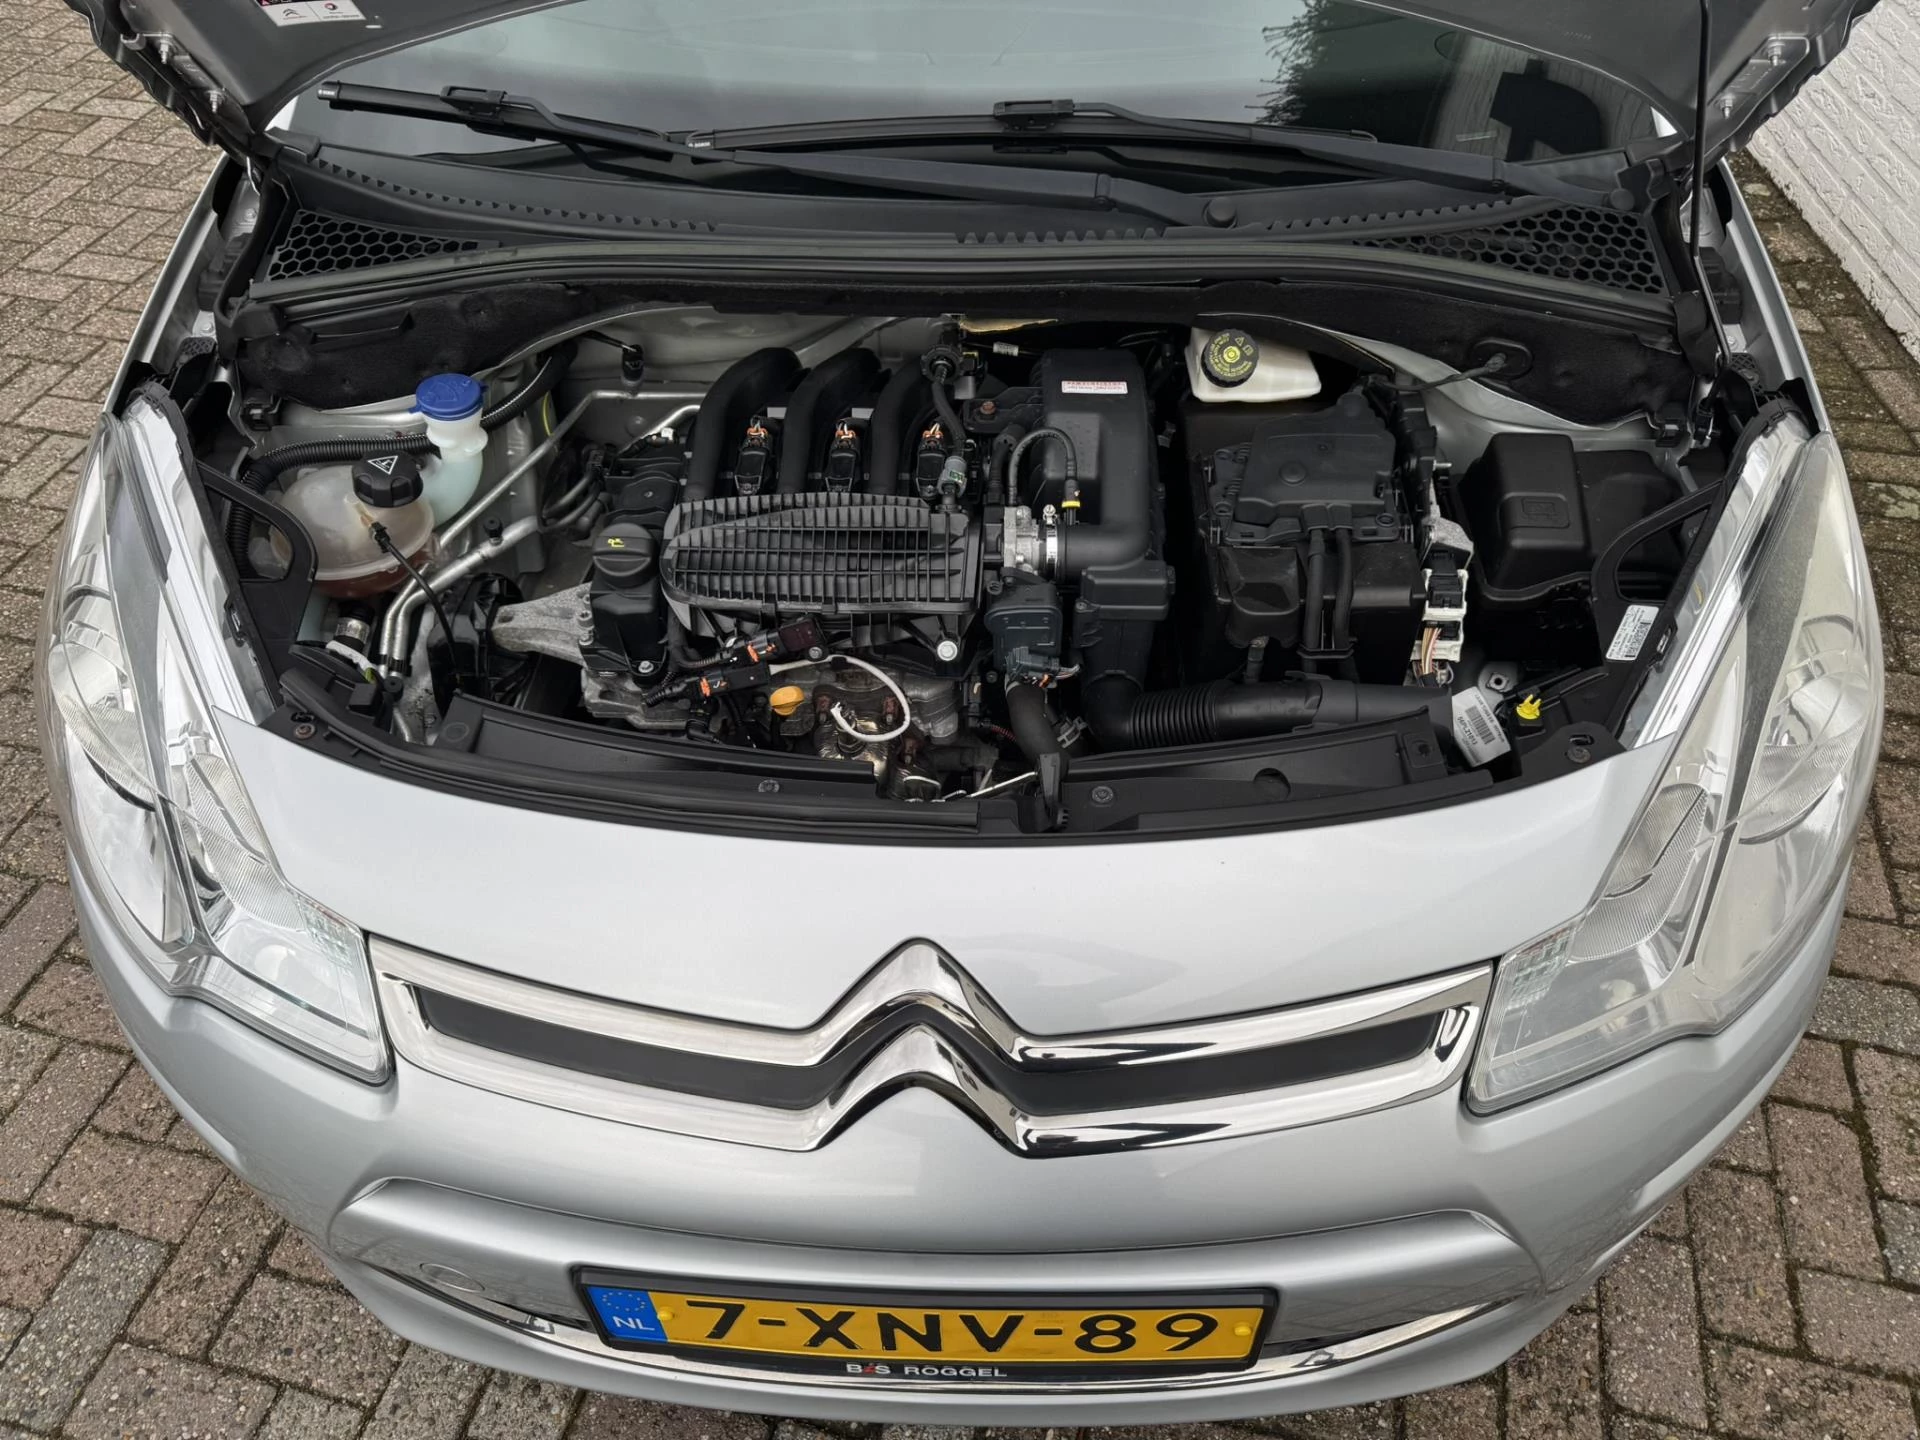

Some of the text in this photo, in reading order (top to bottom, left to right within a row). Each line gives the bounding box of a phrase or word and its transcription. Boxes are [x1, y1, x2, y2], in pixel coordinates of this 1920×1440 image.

[612, 1315, 655, 1331] NL
[686, 1299, 1219, 1354] 7-XNV-89
[904, 1365, 1008, 1377] ROGGEL
